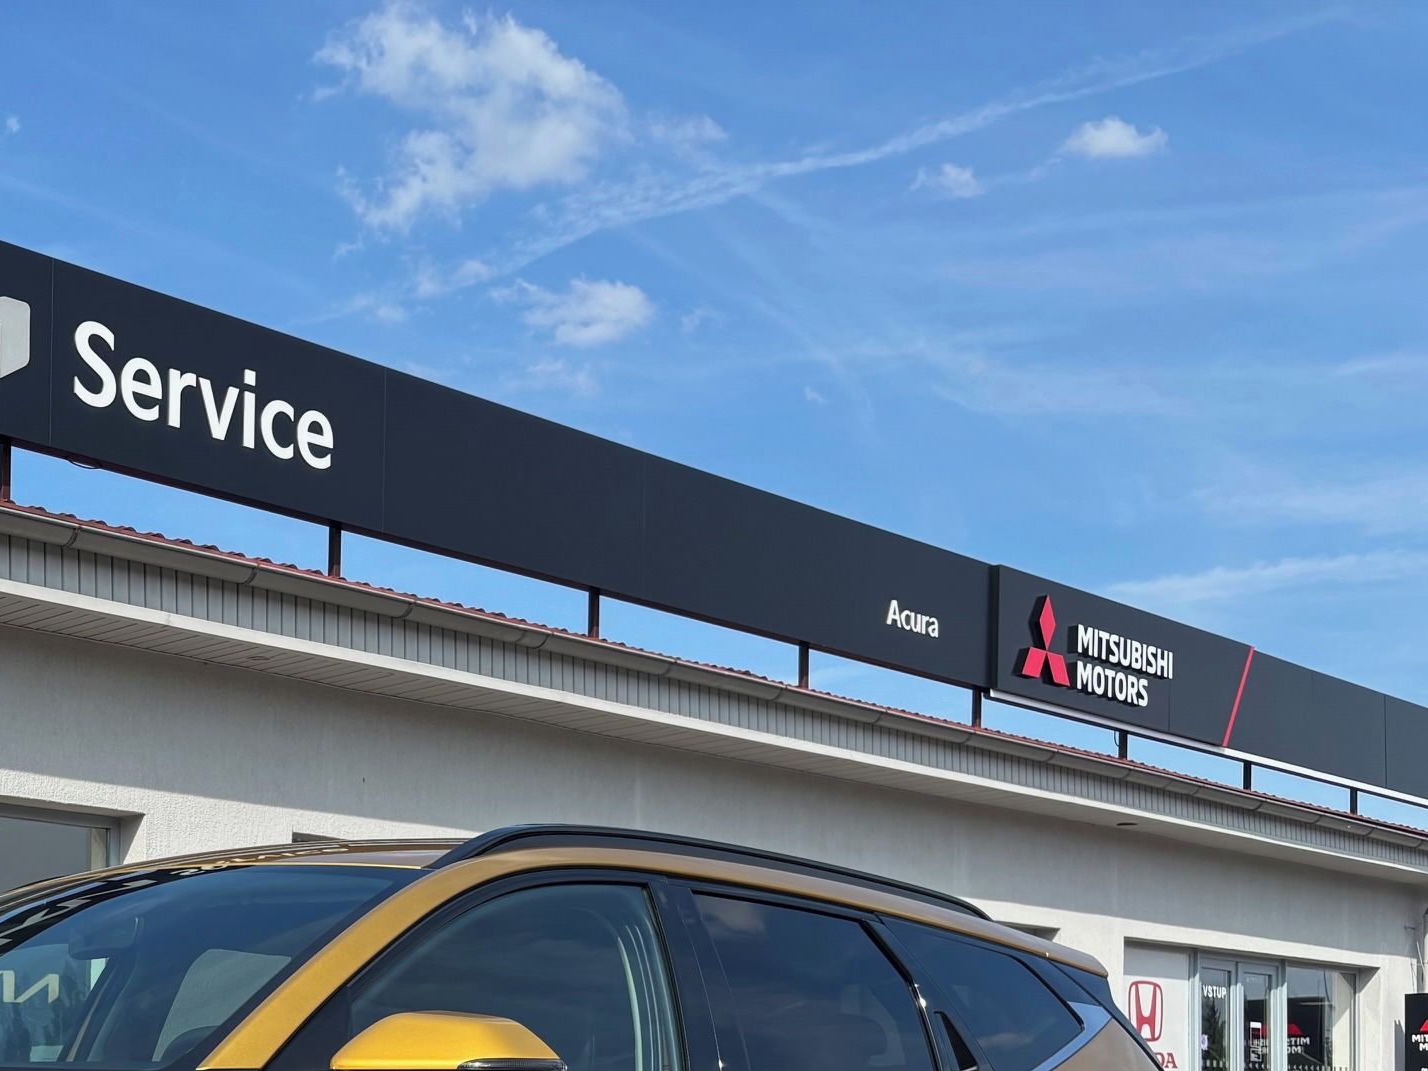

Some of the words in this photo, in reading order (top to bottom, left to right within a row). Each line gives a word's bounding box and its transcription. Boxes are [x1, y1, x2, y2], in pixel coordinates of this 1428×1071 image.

[73, 320, 335, 470] Service
[886, 600, 939, 638] Acura
[1077, 623, 1173, 680] MITSUBISHI
[1076, 660, 1149, 707] MOTORS
[1202, 984, 1227, 999] VSTUP
